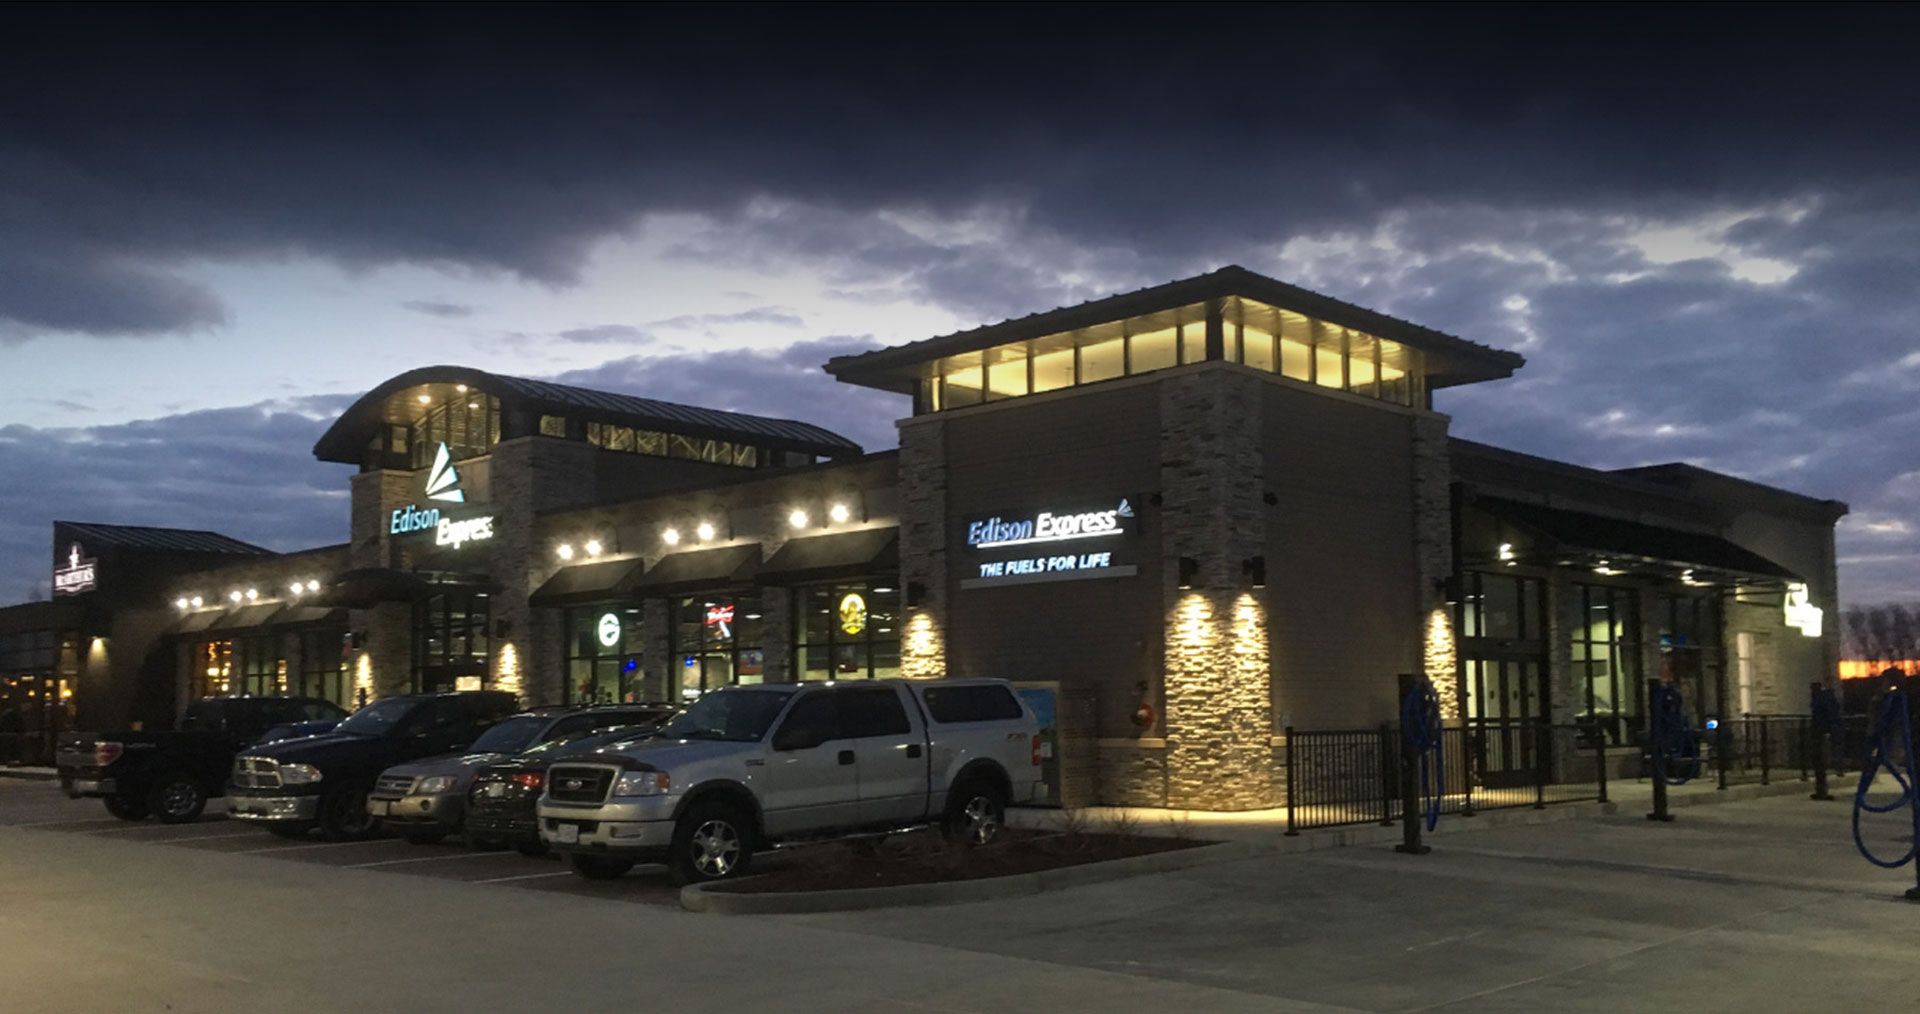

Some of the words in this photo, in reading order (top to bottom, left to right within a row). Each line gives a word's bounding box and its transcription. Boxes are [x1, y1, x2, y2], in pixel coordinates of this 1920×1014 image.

[391, 505, 440, 534] Edison
[968, 517, 1032, 545] Edison
[1036, 510, 1117, 540] Express
[980, 563, 1003, 578] THE
[1005, 557, 1045, 576] FUELS
[1047, 555, 1076, 572] FOR
[1080, 552, 1111, 569] LIFE
